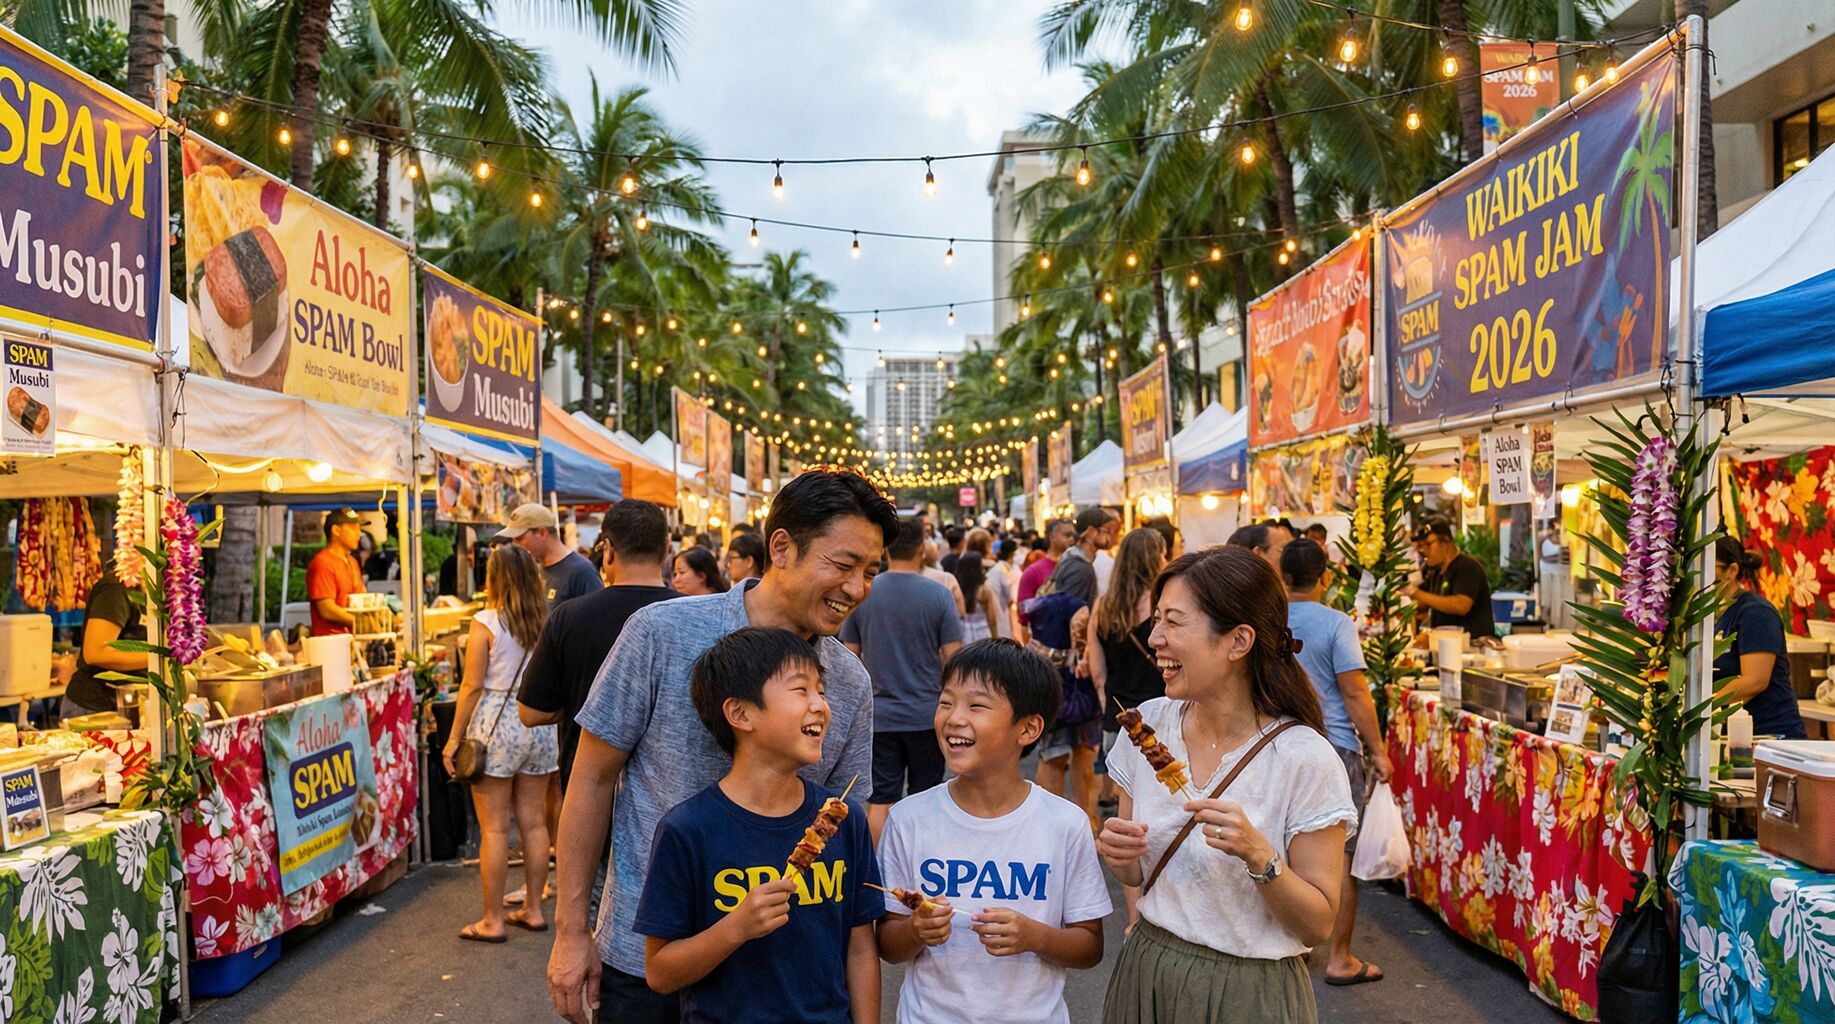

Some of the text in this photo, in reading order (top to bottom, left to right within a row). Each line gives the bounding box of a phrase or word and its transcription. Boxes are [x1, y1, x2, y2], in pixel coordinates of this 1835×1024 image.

[1484, 70, 1523, 83] SPAM
[1503, 84, 1537, 98] 2026
[1465, 131, 1580, 241] WAIKIKI
[310, 229, 391, 316] Aloha
[1453, 193, 1605, 310] SPAM JAM
[294, 298, 404, 373] SPAM Bowl
[472, 304, 535, 382] SPAM
[1401, 300, 1439, 344] SPAM
[9, 343, 48, 368] SPAM
[1469, 298, 1557, 394] 2026
[9, 367, 49, 388] Musubi
[473, 372, 535, 431] Musubi
[1495, 435, 1520, 453] Aloha
[1496, 456, 1522, 474] SPAM
[1499, 476, 1521, 494] Bowl
[296, 713, 341, 754] Aloha
[5, 774, 33, 792] SPAM
[293, 749, 356, 810] SPAM
[920, 858, 1050, 901] SPAM
